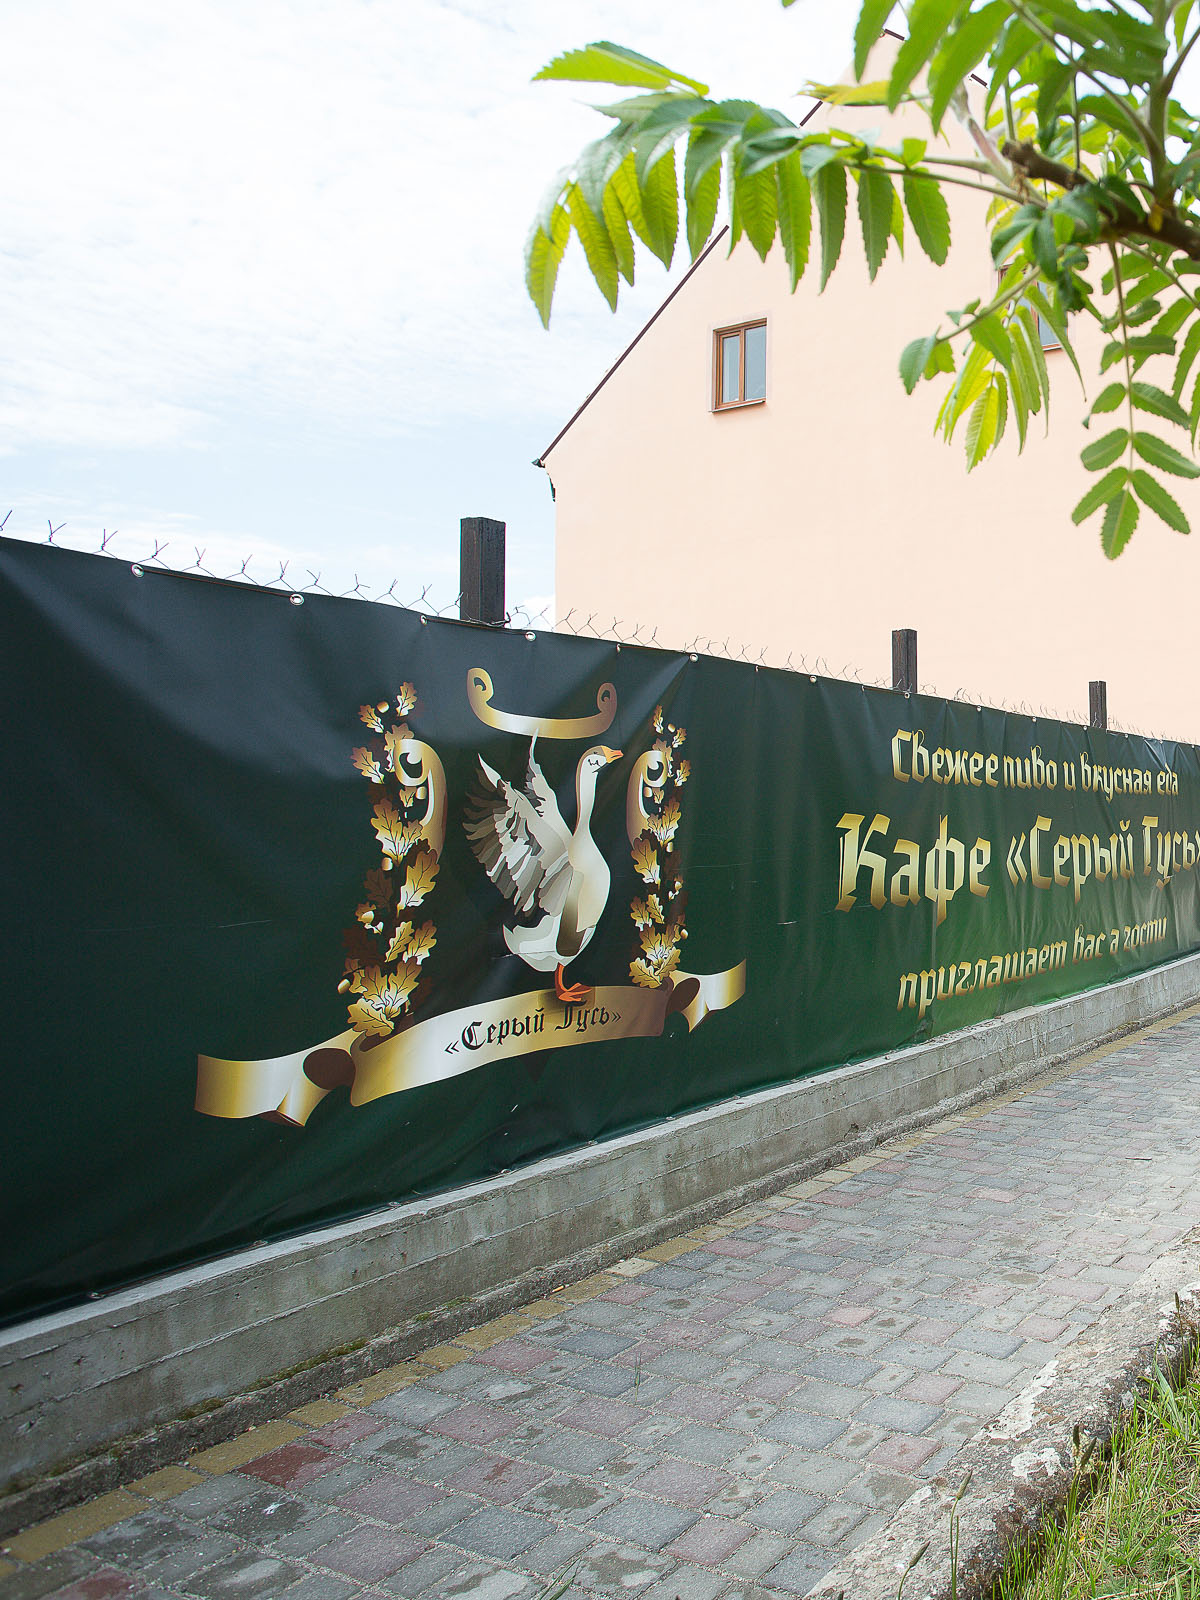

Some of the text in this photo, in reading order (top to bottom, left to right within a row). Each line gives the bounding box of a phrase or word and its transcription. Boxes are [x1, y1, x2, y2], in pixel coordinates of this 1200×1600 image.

[891, 728, 1179, 804] Свежее пиво и вкусная еда
[835, 812, 992, 929] Кафе
[1006, 815, 1135, 905] «Серый
[896, 940, 1068, 1021] приглашает
[1072, 923, 1107, 965] вас
[1123, 915, 1168, 953] гости
[444, 999, 622, 1055] «Серый Гусь»
